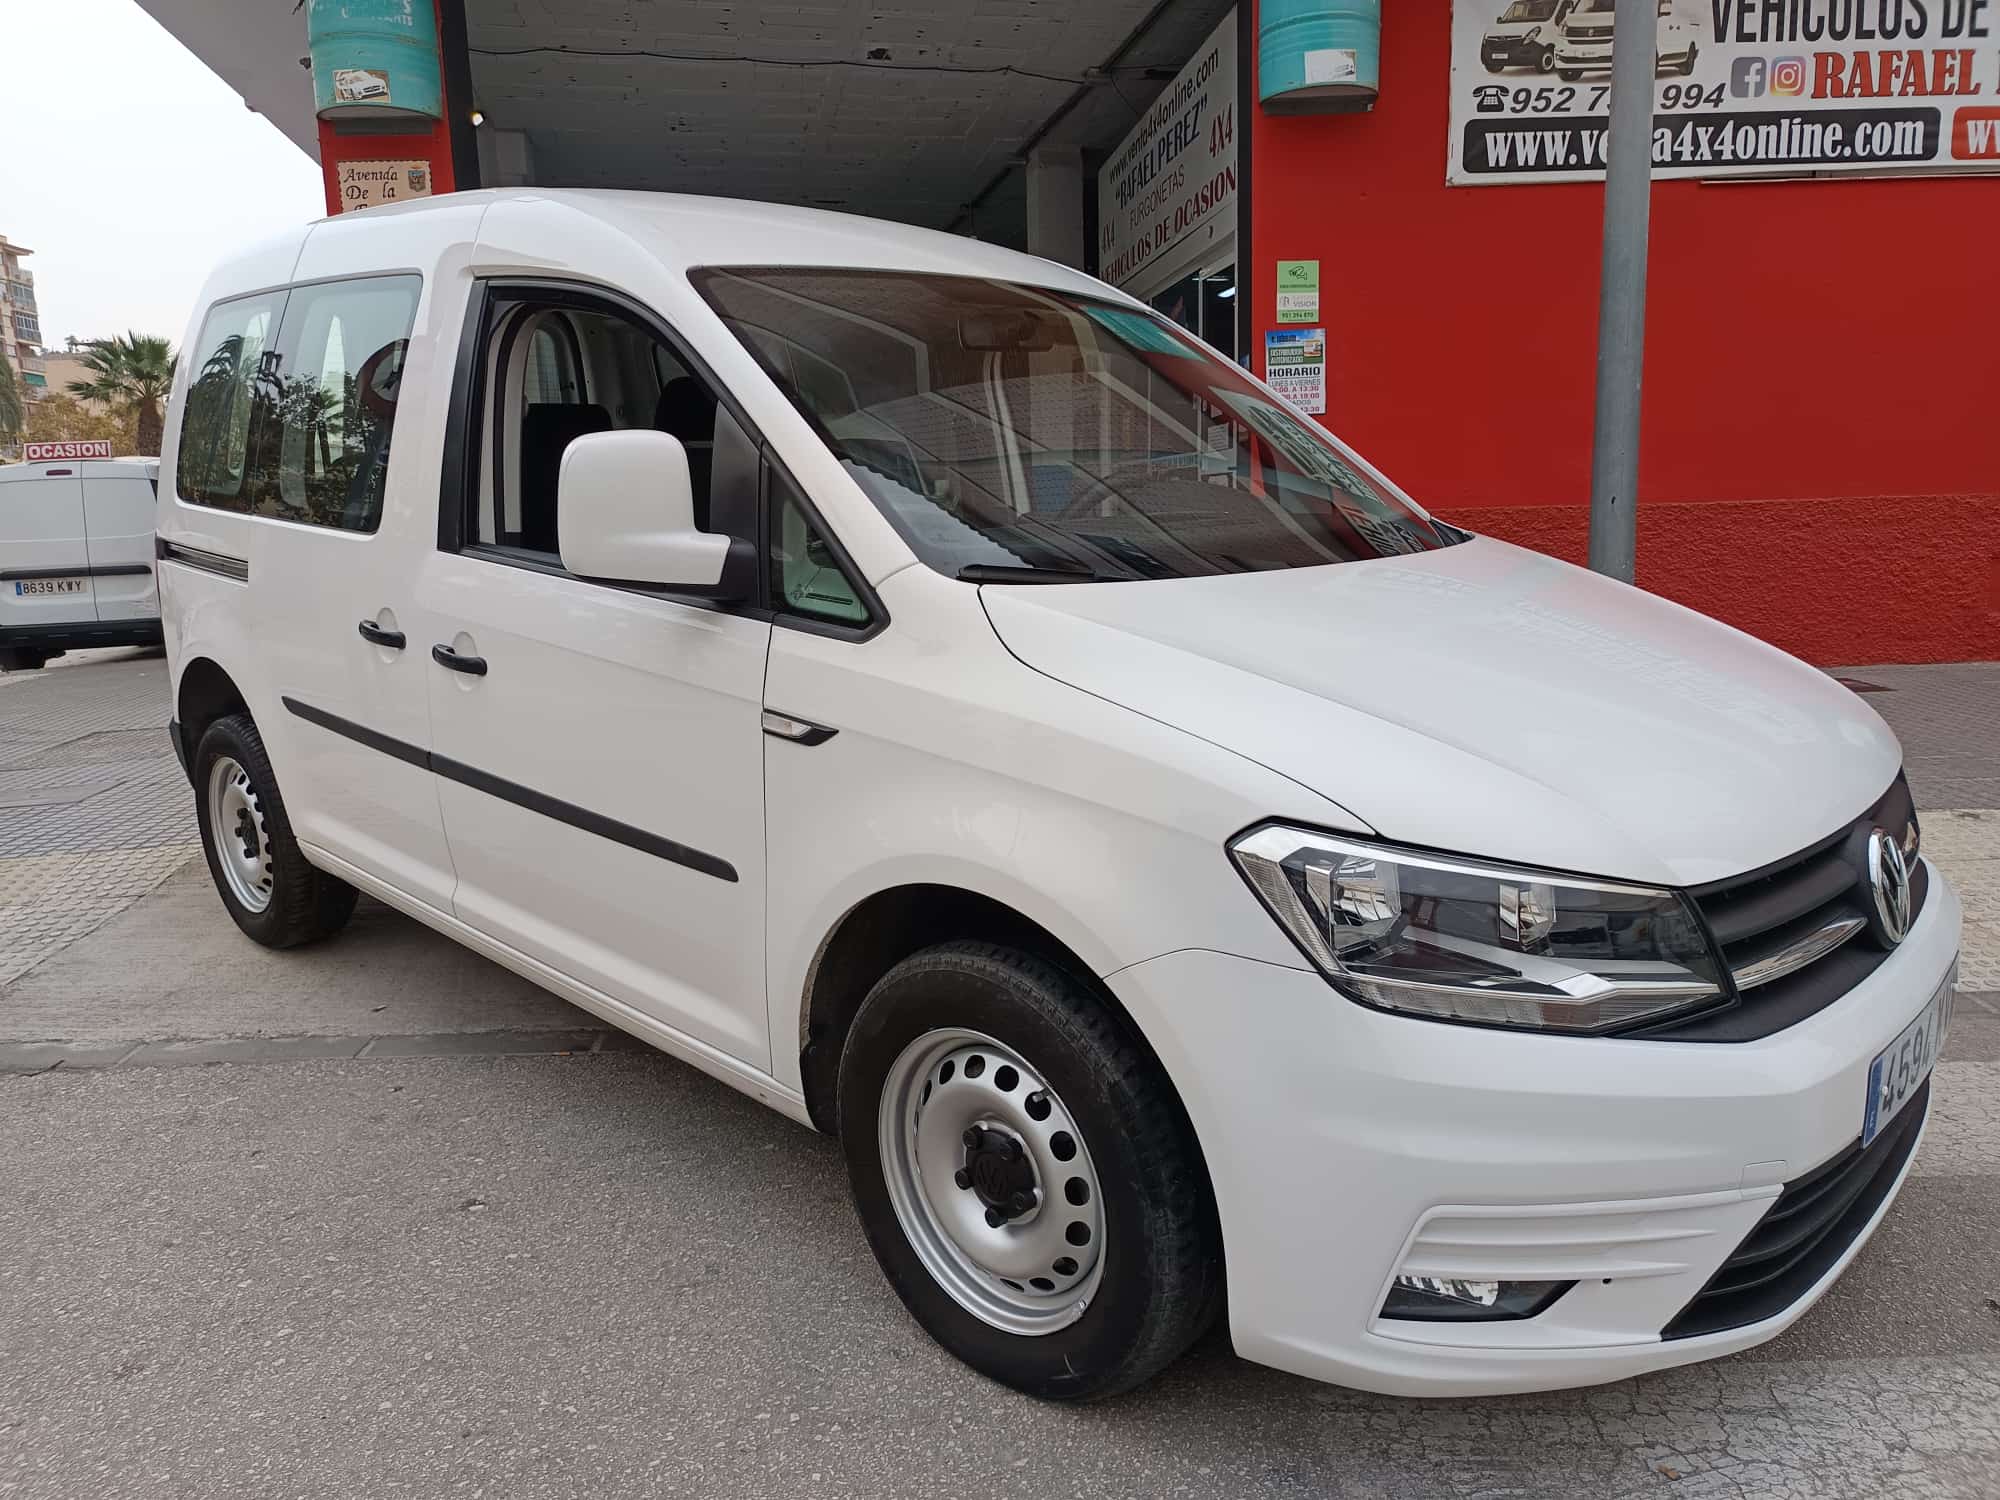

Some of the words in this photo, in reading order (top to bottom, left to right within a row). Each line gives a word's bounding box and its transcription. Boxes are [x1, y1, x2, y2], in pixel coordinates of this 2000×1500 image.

[1711, 0, 1928, 43] VEHICULOS
[1941, 0, 1989, 38] DE
[1811, 49, 1981, 99] RAFAEL
[1510, 87, 1576, 114] 952
[1660, 83, 1727, 110] 994
[1485, 117, 1925, 167] www.va4x4online.com
[343, 166, 398, 183] Avenida
[1129, 164, 1185, 230] FURGONETAS
[1209, 103, 1233, 158] 4X4
[345, 185, 369, 200] De
[382, 182, 396, 199] la
[1154, 215, 1171, 250] DE
[1174, 160, 1236, 227] OCASION
[1269, 366, 1321, 378] HORARIO
[28, 443, 107, 459] OCASION
[23, 581, 54, 594] 8639
[57, 580, 81, 593] KWY
